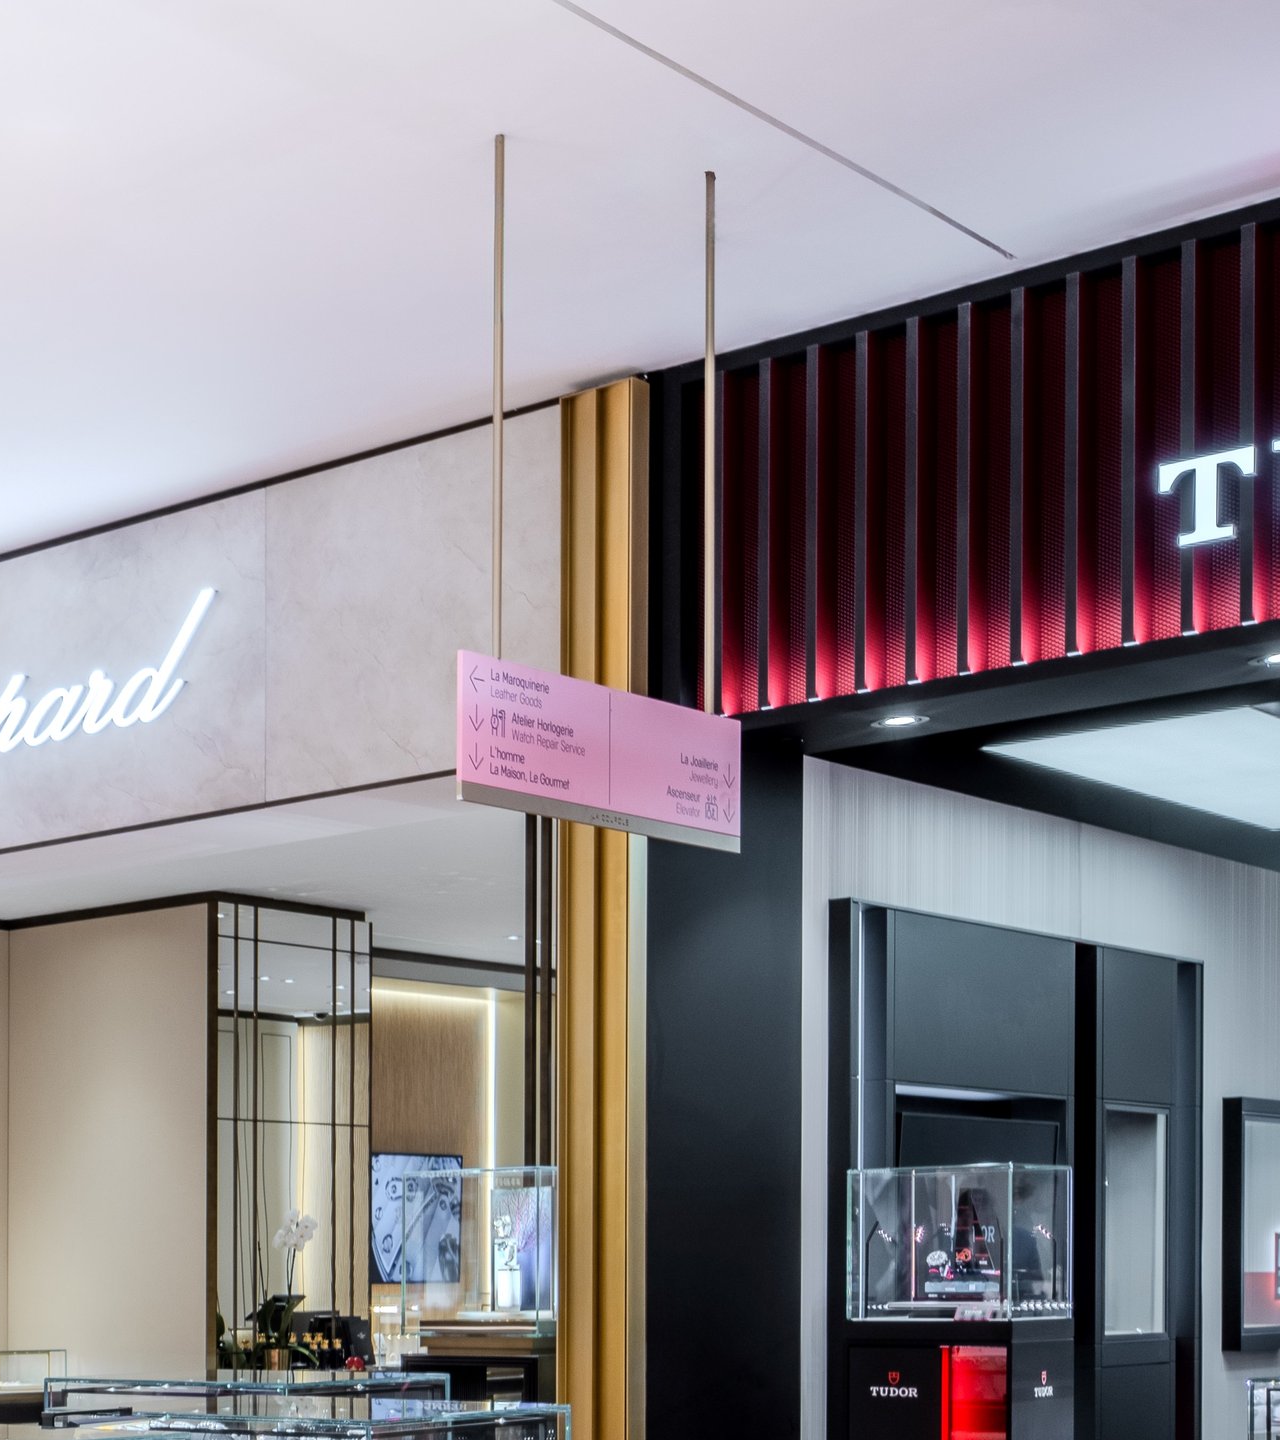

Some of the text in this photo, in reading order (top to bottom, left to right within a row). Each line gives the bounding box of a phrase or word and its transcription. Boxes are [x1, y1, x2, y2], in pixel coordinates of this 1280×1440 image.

[1158, 440, 1280, 548] T
[490, 668, 550, 694] La Maroquinerie
[490, 685, 542, 709] Leather Goods
[512, 712, 574, 738] Atelier Horlogerie
[490, 745, 525, 764] L'homme
[512, 729, 585, 757] Watch Repair Service
[680, 752, 719, 771] La Joaillerie
[489, 762, 570, 790] La Maison, Le Gourmet
[666, 785, 701, 802] Ascenseur
[870, 1386, 918, 1398] TUDOR
[1034, 1386, 1053, 1398] TUDOR
